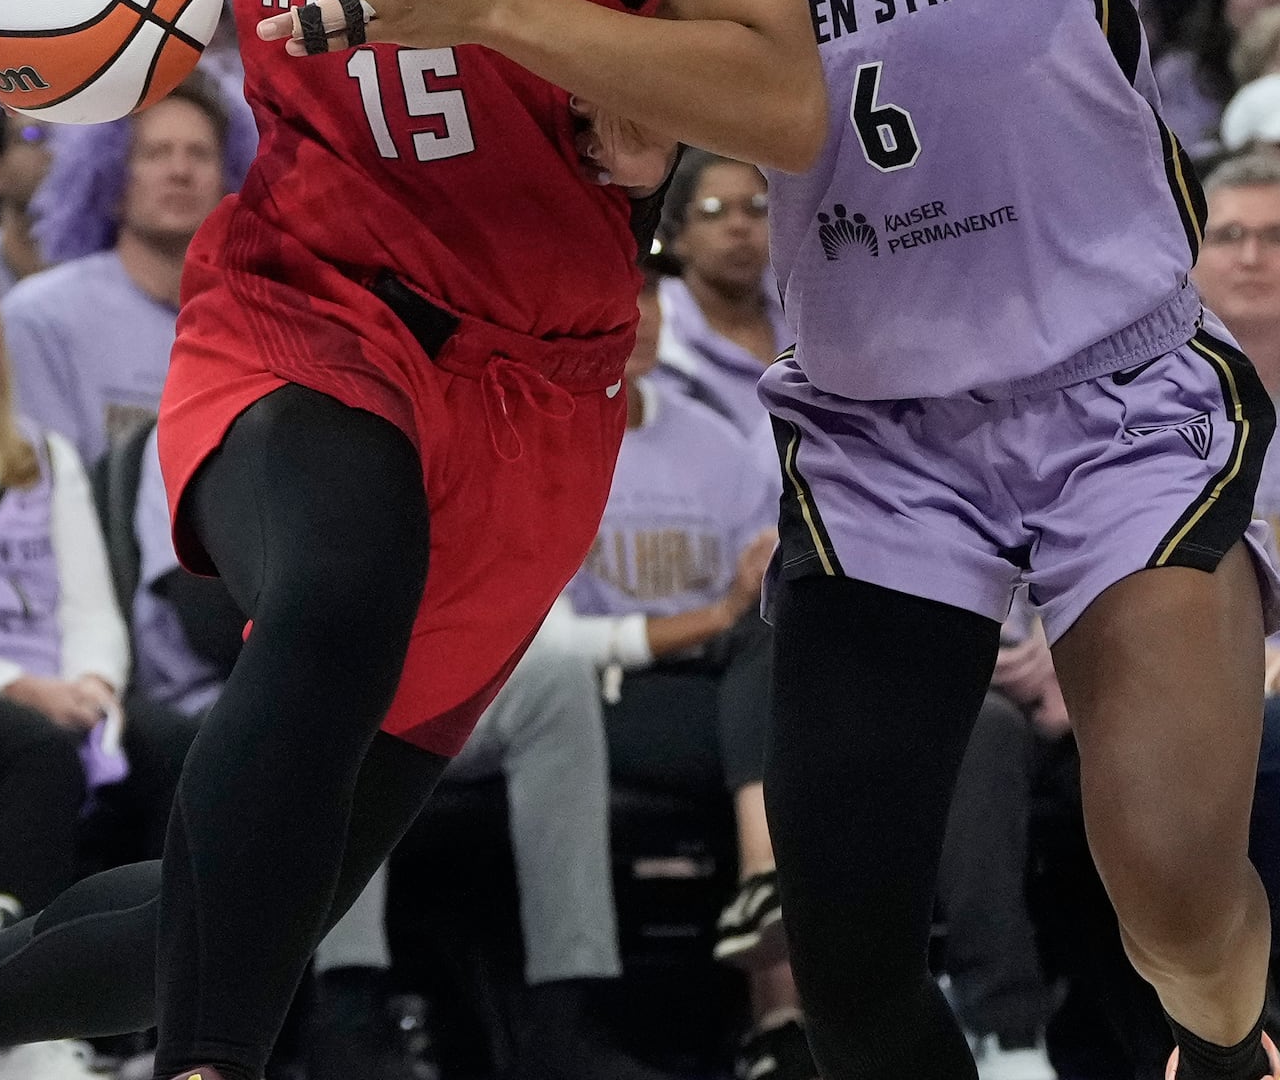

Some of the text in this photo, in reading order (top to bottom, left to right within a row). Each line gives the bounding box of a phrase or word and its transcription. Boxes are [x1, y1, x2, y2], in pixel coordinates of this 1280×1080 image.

[346, 46, 475, 162] 15
[850, 61, 921, 172] 6
[884, 200, 947, 232] KAISER
[887, 205, 1018, 254] PERMANENTE
